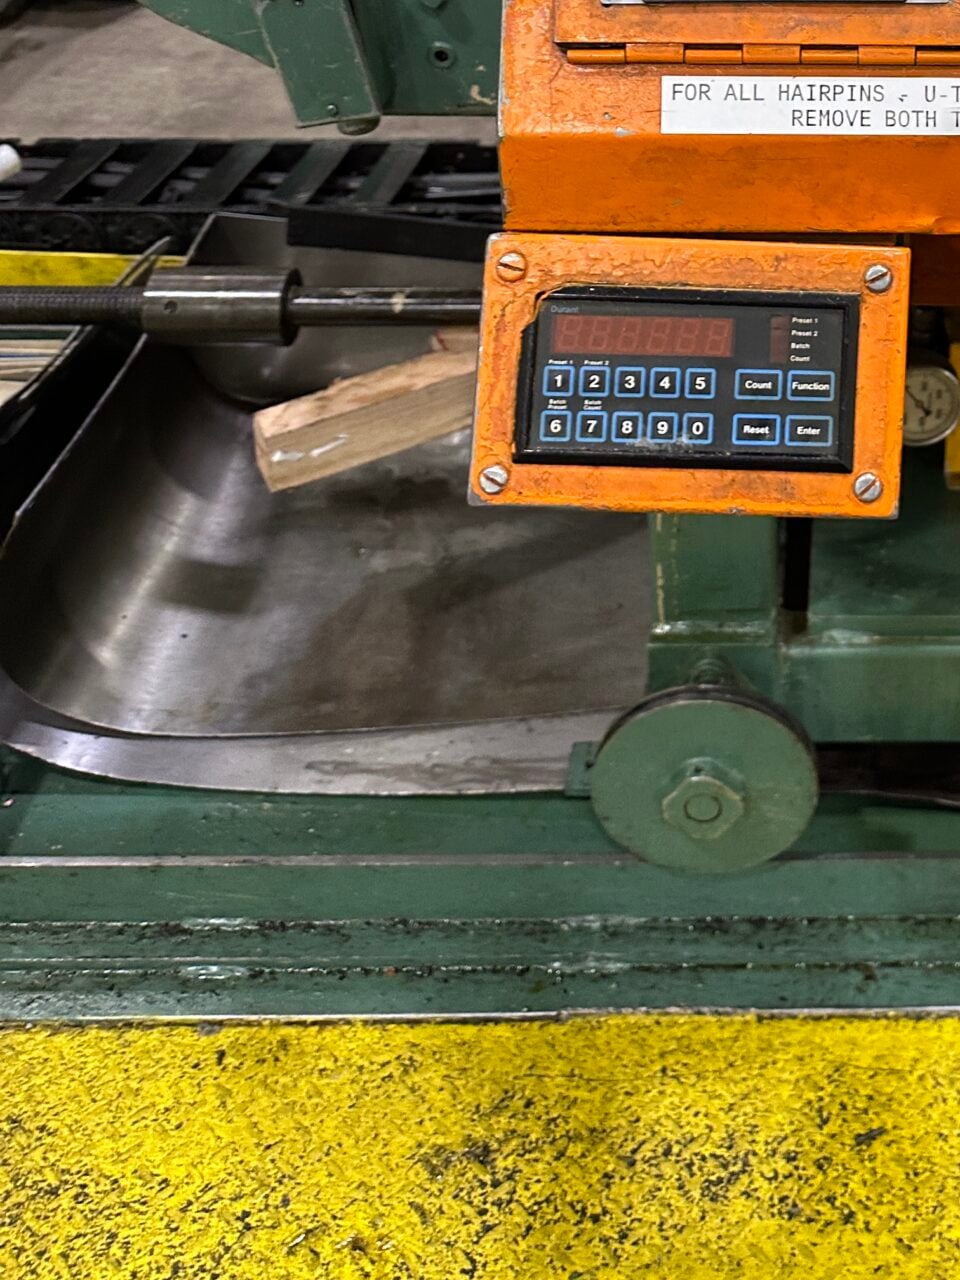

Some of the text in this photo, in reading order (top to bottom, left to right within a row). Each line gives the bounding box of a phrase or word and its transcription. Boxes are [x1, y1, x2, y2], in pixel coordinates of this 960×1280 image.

[671, 83, 711, 101] FOR
[724, 83, 765, 101] ALL
[778, 84, 884, 103] HAIRPINS
[791, 109, 871, 127] REMOVE
[885, 110, 937, 128] BOTH
[554, 374, 563, 388] 1
[588, 374, 600, 388] 2
[624, 375, 636, 389] 3
[658, 376, 671, 390] 4
[695, 376, 706, 390] 5
[744, 380, 773, 390] Count
[792, 381, 830, 391] Function
[550, 419, 562, 433] 6
[586, 420, 598, 433] 7
[621, 420, 633, 434] 8
[656, 421, 669, 435] 9
[692, 421, 704, 435] 0
[743, 425, 770, 434] Reset
[796, 426, 821, 436] Enter
